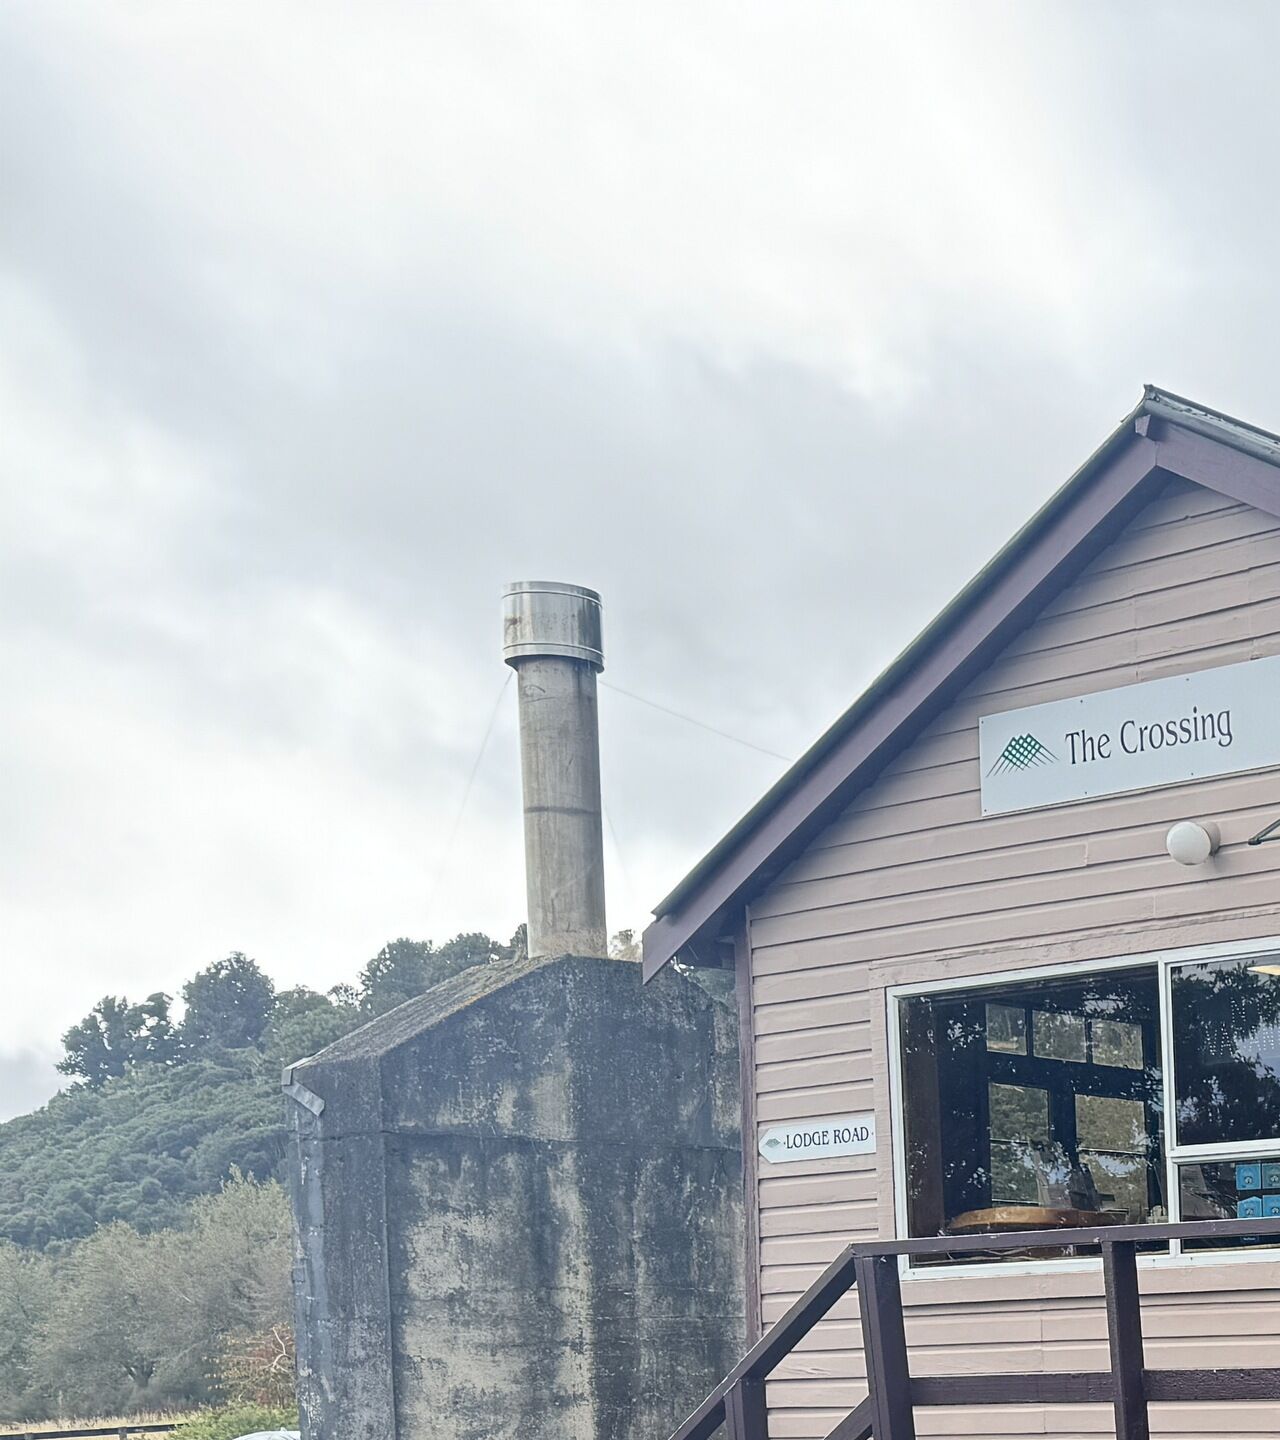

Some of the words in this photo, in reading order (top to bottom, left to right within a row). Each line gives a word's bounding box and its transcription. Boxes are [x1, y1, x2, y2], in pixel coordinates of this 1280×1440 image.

[1065, 728, 1111, 765] The
[1119, 706, 1234, 754] Crossing
[785, 1130, 830, 1149] LODGE
[833, 1126, 869, 1145] ROAD
